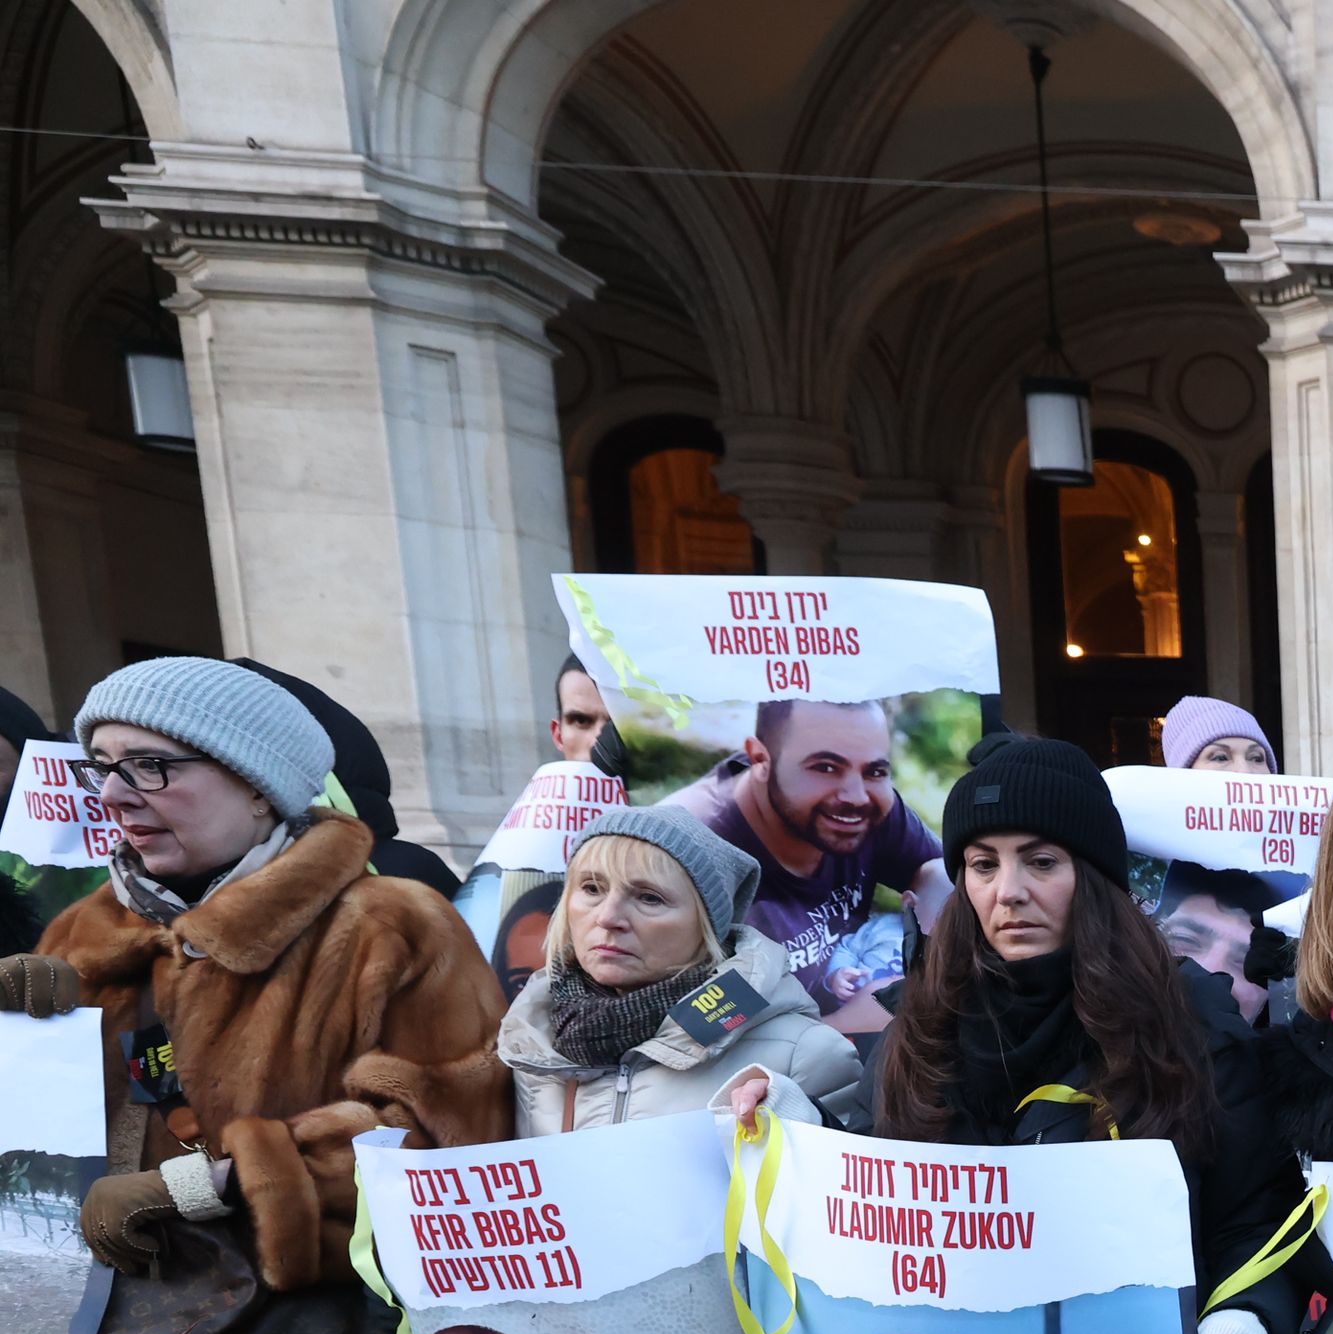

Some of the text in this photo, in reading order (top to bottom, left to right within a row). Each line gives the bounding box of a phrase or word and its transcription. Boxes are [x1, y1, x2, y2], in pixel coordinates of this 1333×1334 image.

[728, 591, 828, 624] ירדן ביבס
[704, 626, 860, 656] YARDEN BIBAS
[766, 659, 810, 693] (34)
[24, 791, 80, 823] YOSSI
[1225, 781, 1265, 806] ברמן
[1185, 806, 1224, 831] GALI
[1229, 808, 1264, 833] AND
[1268, 809, 1295, 835] ZIV
[1262, 836, 1295, 866] (26)
[691, 983, 725, 1014] 100
[404, 1159, 543, 1207] כפיר ביבס
[841, 1152, 1009, 1204] ולדימיר זוקוב
[410, 1203, 566, 1251] KFIR BIBAS
[826, 1195, 1035, 1250] VLADIMIR ZUKOV
[892, 1250, 946, 1298] (64)
